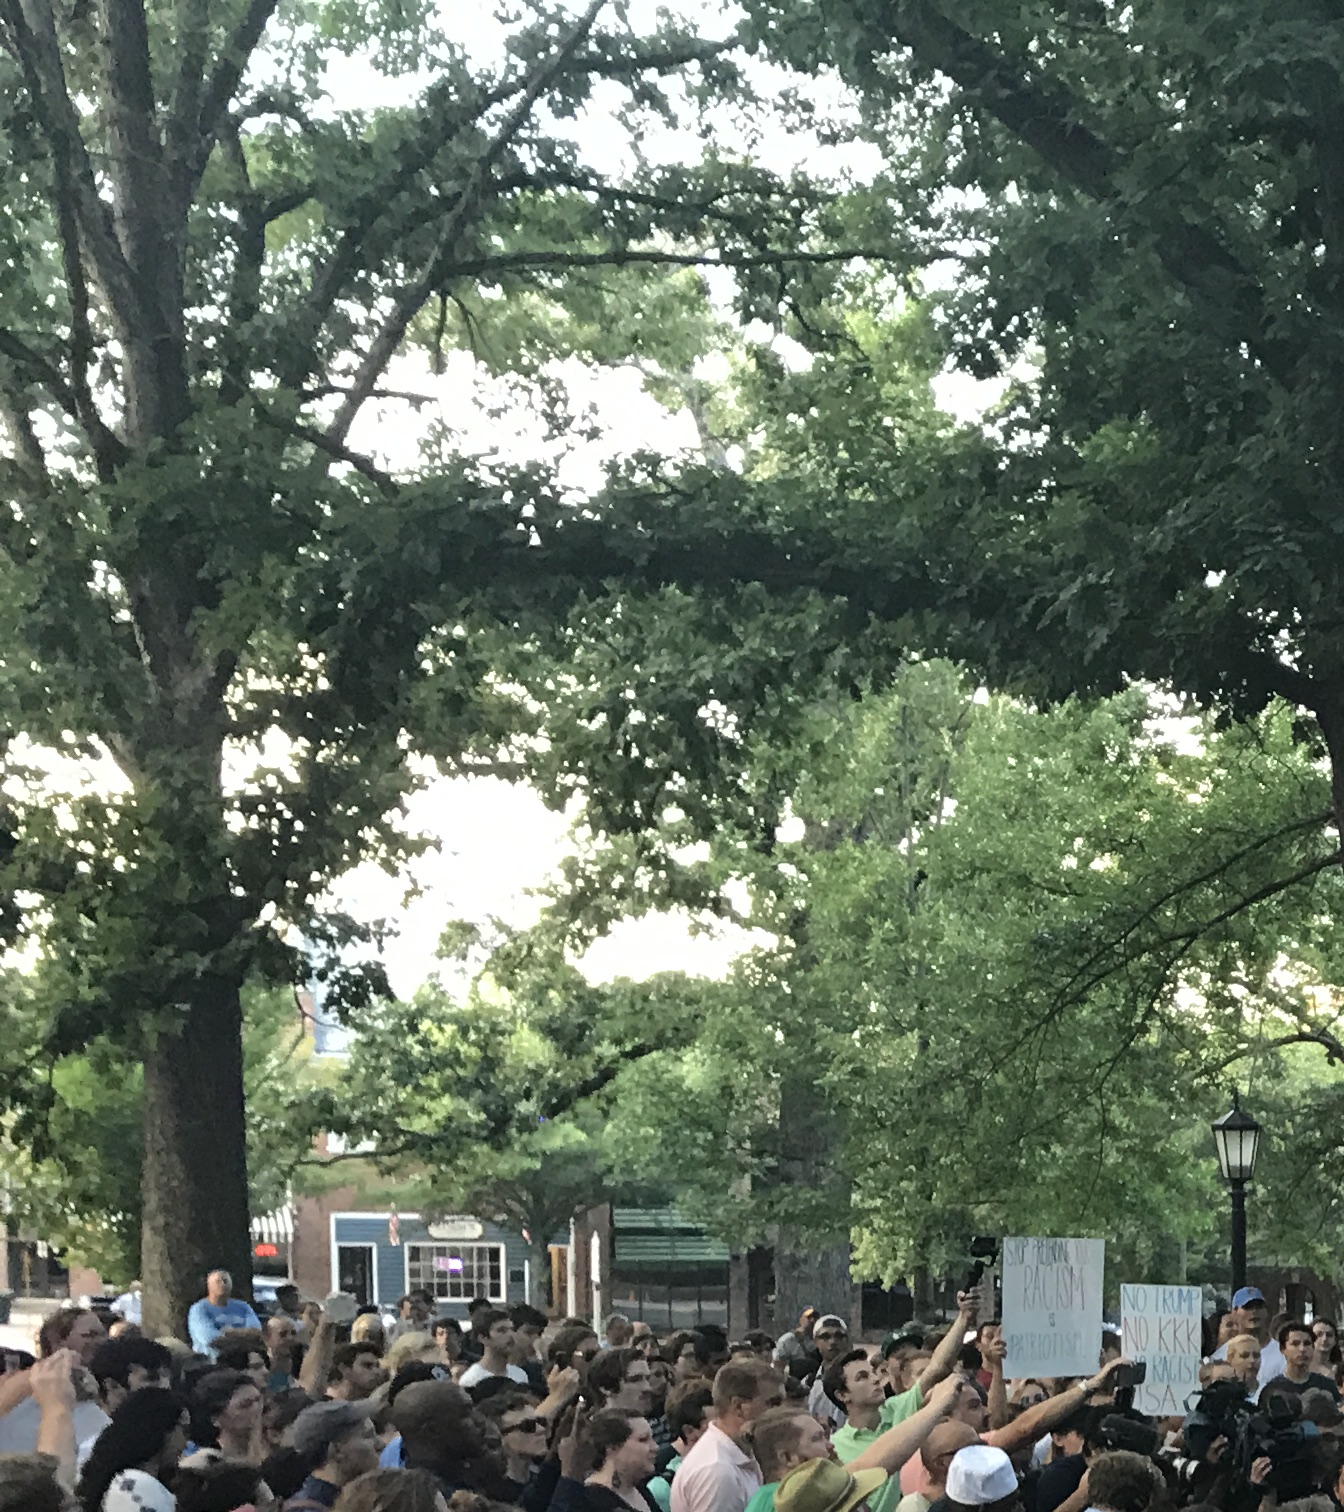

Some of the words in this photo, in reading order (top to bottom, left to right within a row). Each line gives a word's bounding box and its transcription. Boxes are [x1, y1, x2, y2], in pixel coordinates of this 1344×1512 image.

[1023, 1264, 1085, 1312] RACISM
[1122, 1285, 1148, 1313] NO
[1154, 1286, 1201, 1316] TRUMP
[1123, 1316, 1149, 1352] NO
[1158, 1317, 1200, 1354] KKK
